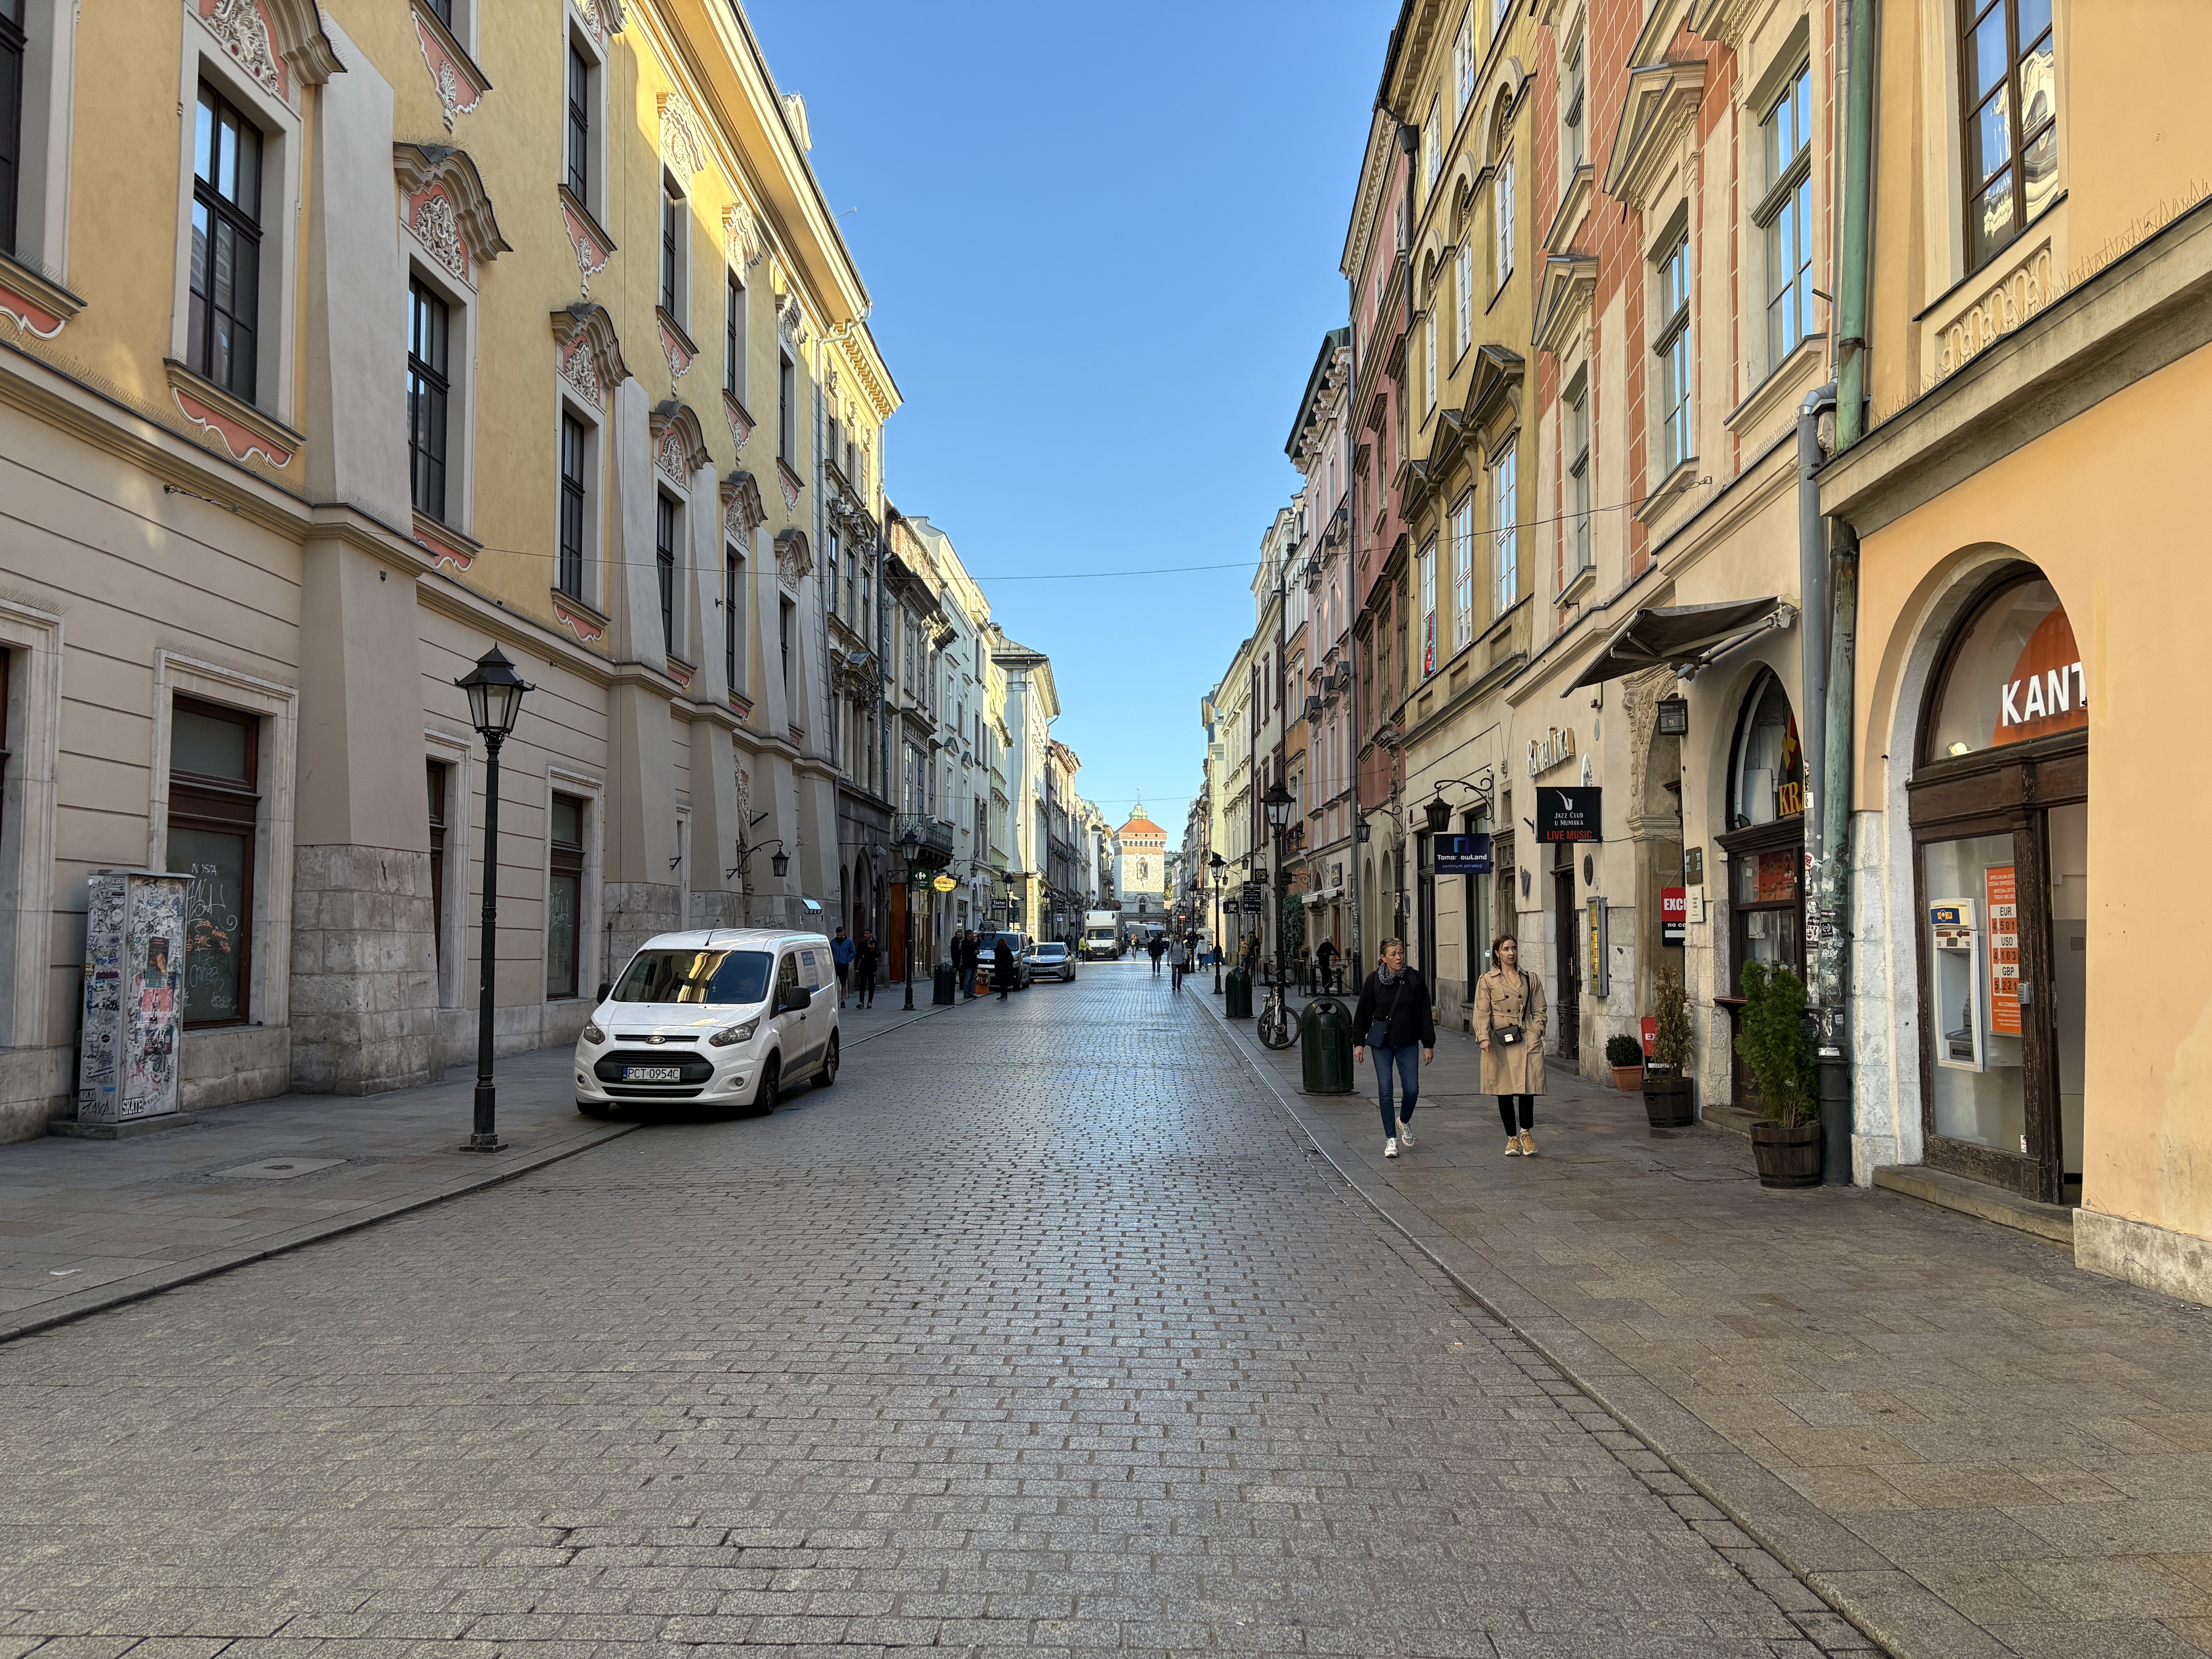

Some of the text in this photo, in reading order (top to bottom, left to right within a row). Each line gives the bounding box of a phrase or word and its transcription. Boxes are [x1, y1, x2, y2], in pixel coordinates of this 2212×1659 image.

[1547, 830, 1592, 840] LIVE MUSIC
[2000, 907, 2012, 916] EUR
[1992, 921, 2015, 932] 4,501
[2001, 937, 2013, 946] USD
[1994, 951, 2016, 963] 4,103
[2002, 967, 2014, 975] GBP
[628, 1068, 679, 1079] PCT 0954C
